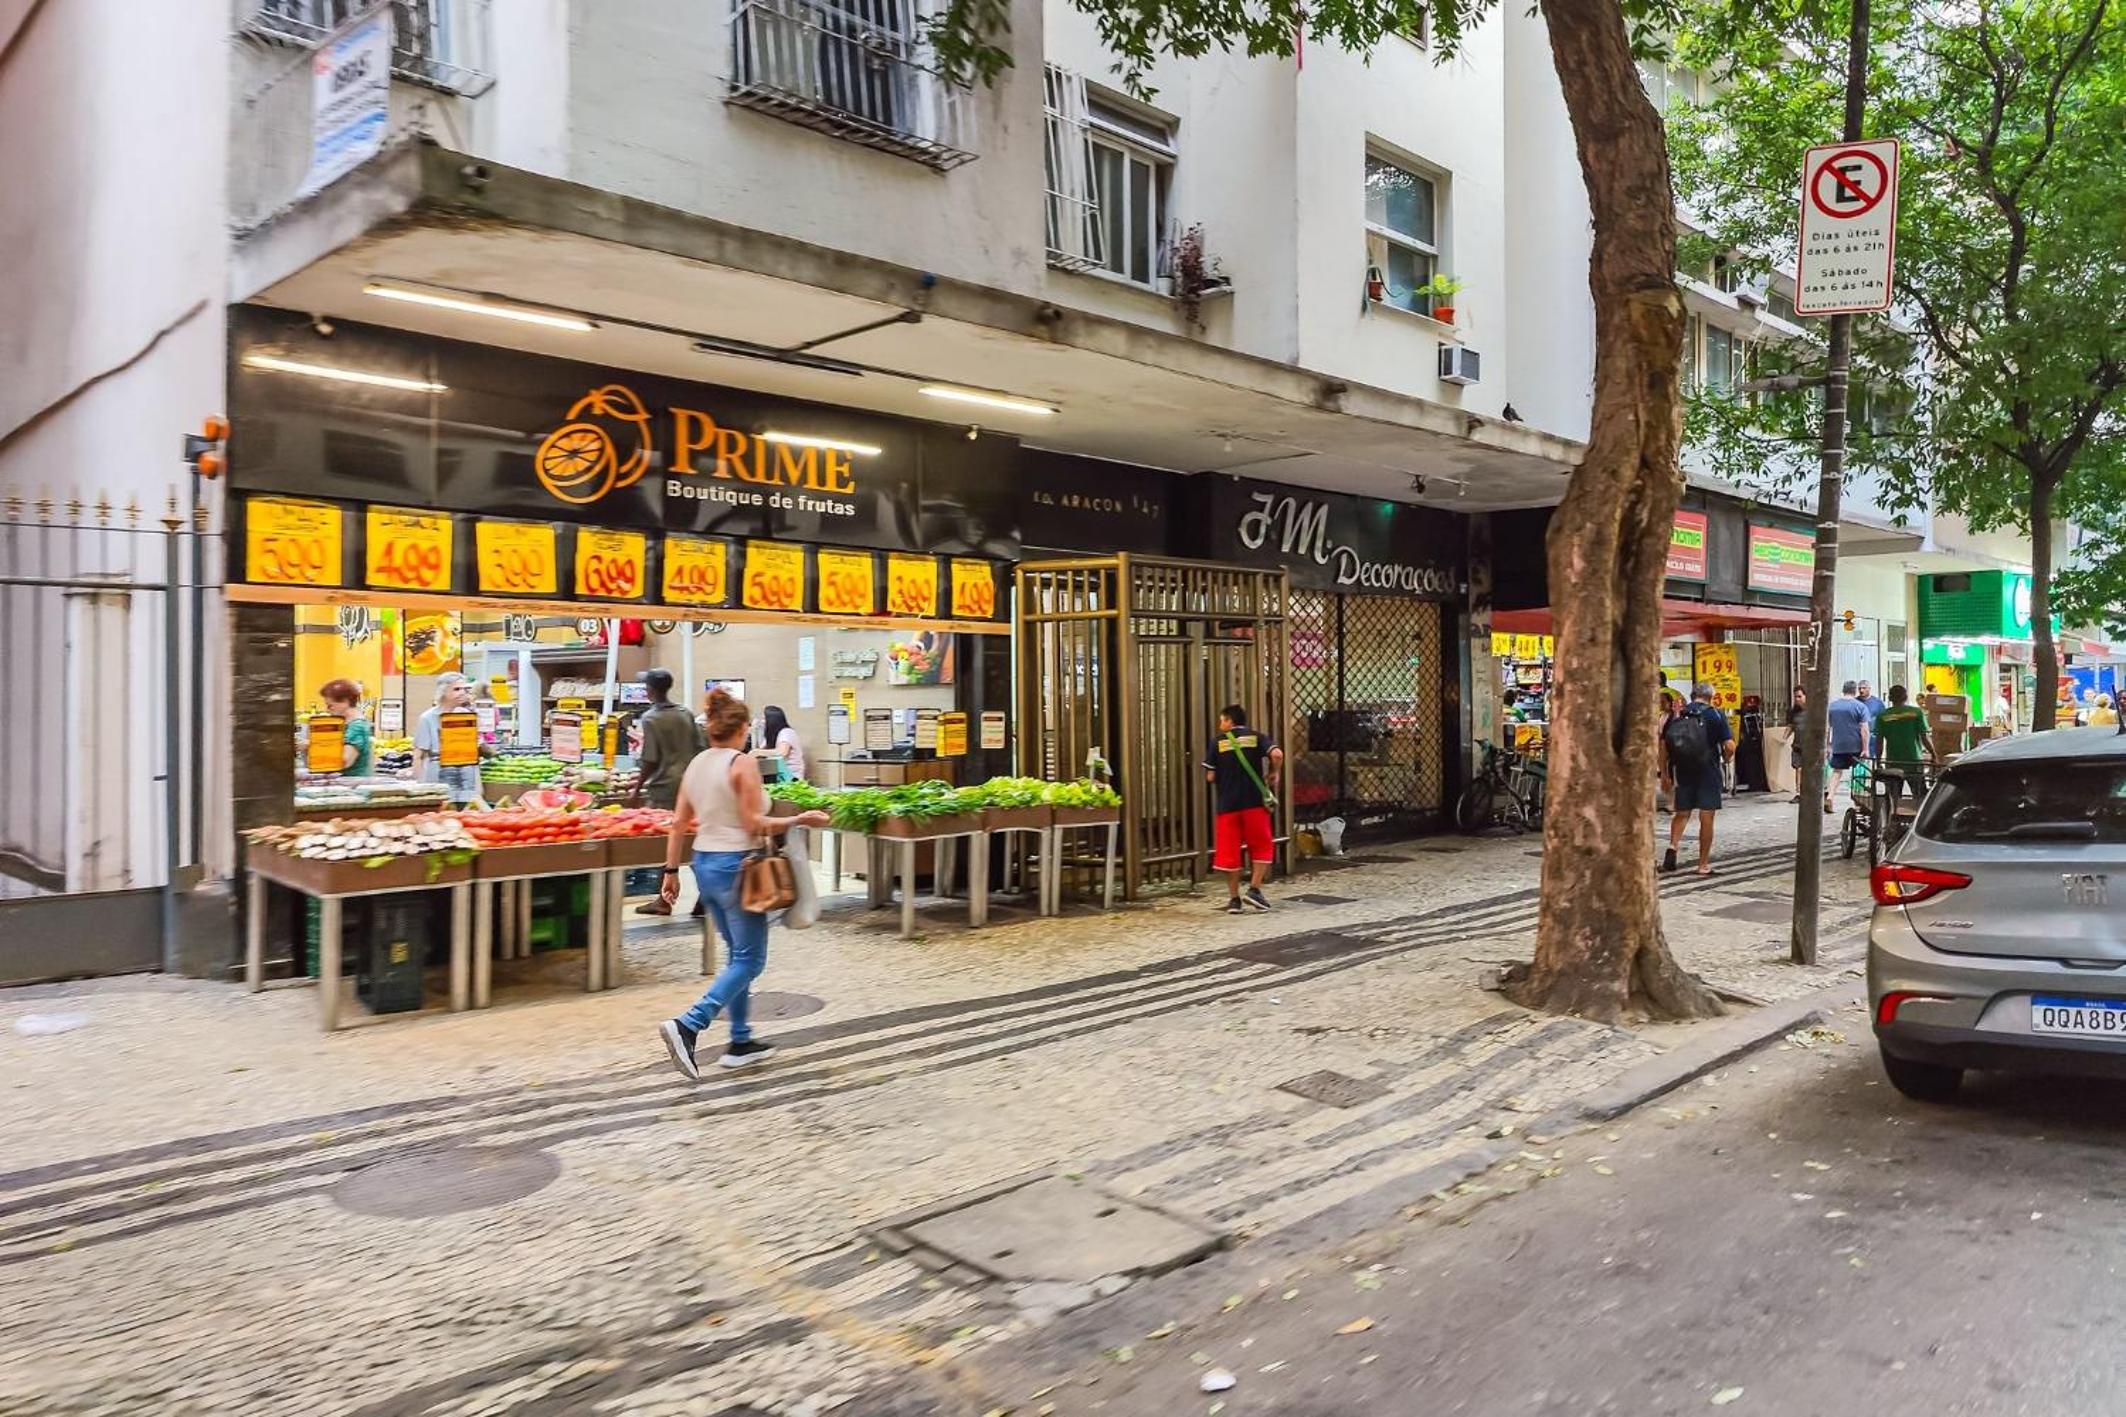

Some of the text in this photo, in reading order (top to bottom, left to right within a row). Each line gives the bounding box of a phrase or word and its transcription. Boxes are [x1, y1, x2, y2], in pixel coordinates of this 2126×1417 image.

[1836, 164, 1864, 203] E
[1812, 232, 1840, 241] Dias
[1806, 248, 1829, 256] das
[1833, 244, 1841, 254] 6
[1864, 242, 1885, 252] 21h
[1821, 267, 1867, 278] Sábado
[1804, 284, 1826, 293] das
[1830, 282, 1838, 291] 6
[668, 406, 856, 494] PRIME
[666, 479, 856, 516] Boutique de frutas
